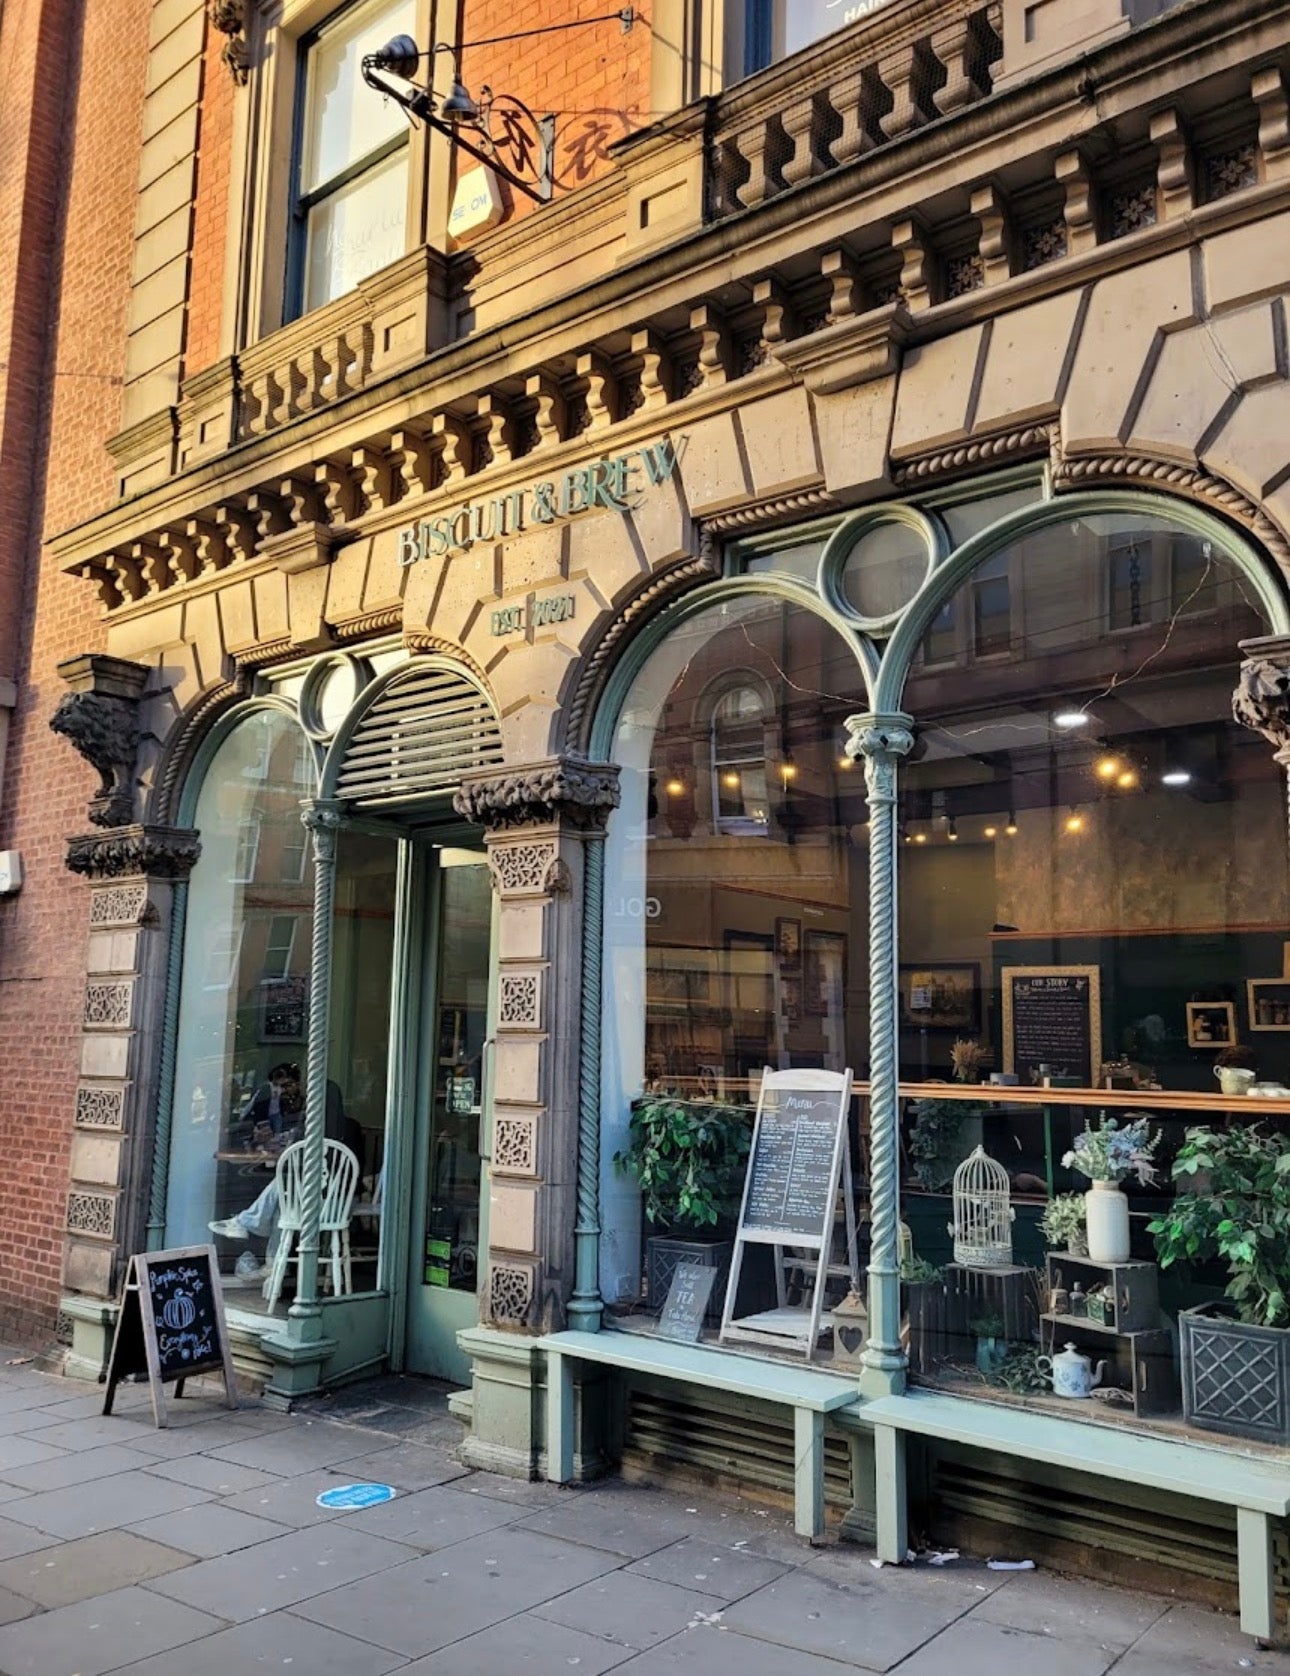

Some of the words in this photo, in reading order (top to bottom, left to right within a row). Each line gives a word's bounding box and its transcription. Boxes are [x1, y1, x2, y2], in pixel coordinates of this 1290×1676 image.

[399, 488, 528, 567] BISCUIT
[531, 481, 558, 523] &
[562, 433, 690, 512] BREW
[531, 595, 573, 627] 2021
[1046, 977, 1069, 987] STORY
[676, 1290, 695, 1305] TEA
